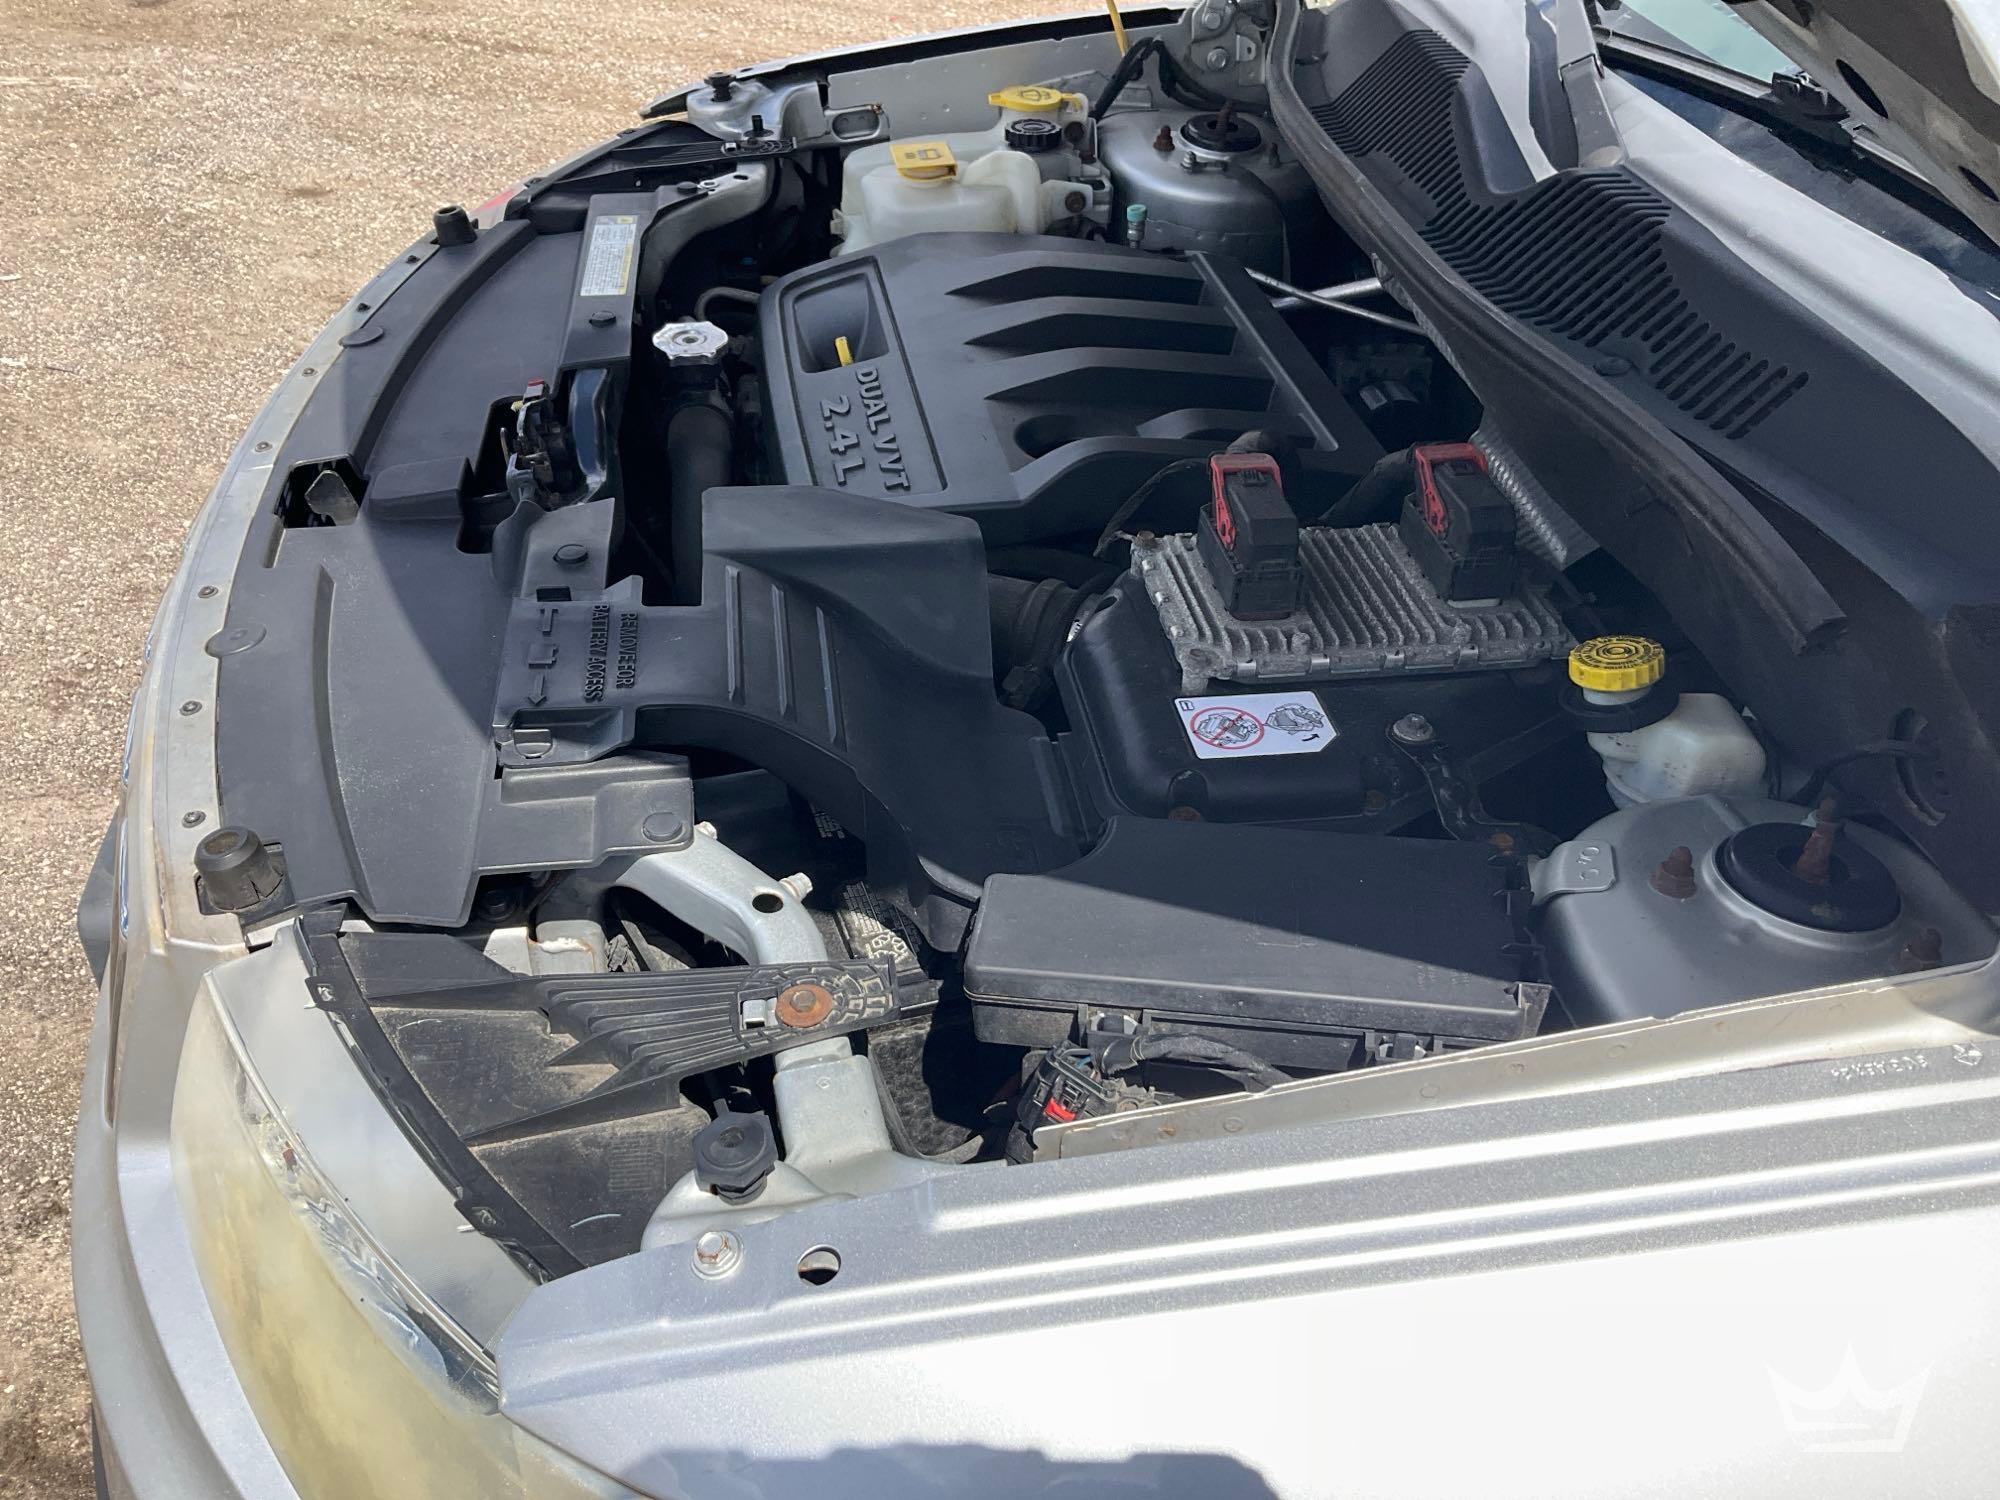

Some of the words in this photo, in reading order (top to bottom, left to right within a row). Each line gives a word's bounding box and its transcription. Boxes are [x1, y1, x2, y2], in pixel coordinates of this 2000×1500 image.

[820, 394, 865, 486] 2.4L
[856, 367, 890, 435] DUAL
[874, 433, 911, 491] VVT
[589, 604, 610, 656] BATTERY
[618, 611, 638, 662] REMOVE
[584, 656, 606, 702] ACCESS
[616, 662, 635, 689] FOR
